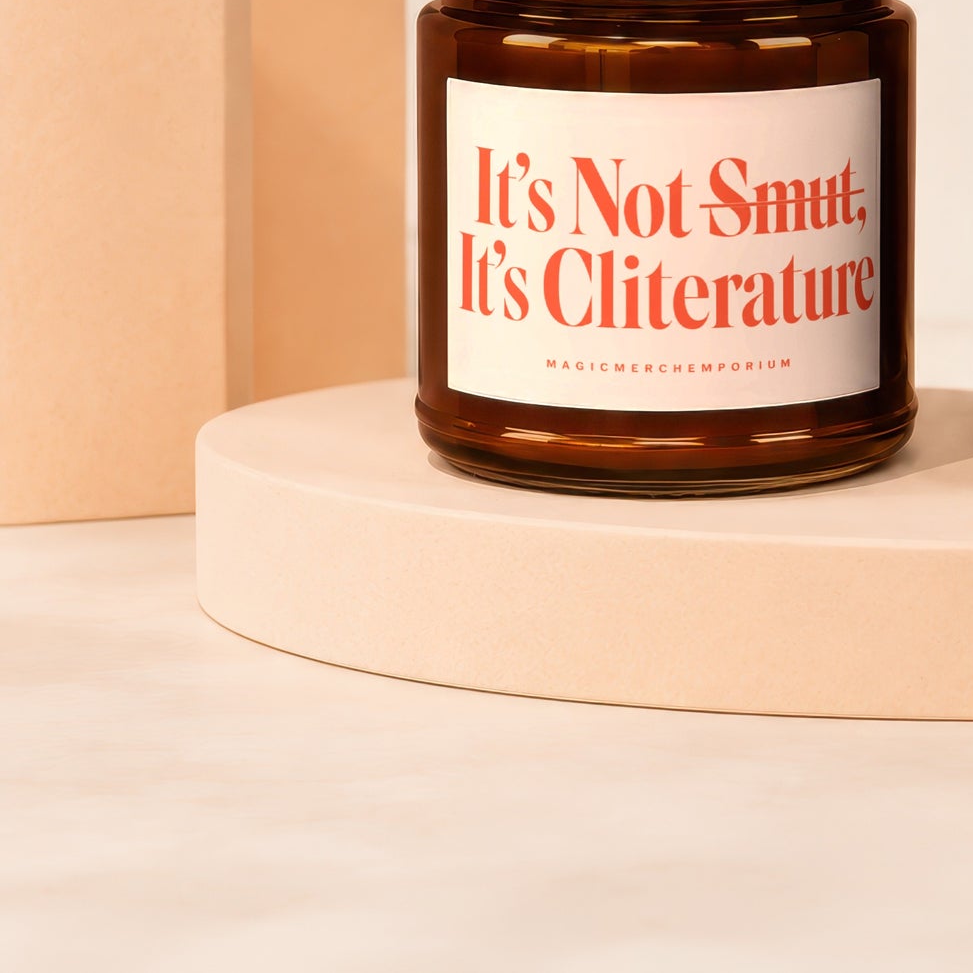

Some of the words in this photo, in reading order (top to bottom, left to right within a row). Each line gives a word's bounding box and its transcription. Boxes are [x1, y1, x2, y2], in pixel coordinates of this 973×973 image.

[475, 145, 556, 233] It’s
[569, 156, 693, 240] Not
[707, 156, 868, 240] Smut,
[459, 230, 530, 322] It’s
[542, 246, 875, 331] Cliterature
[545, 358, 793, 374] MAGICMERCHEMPORIUM
